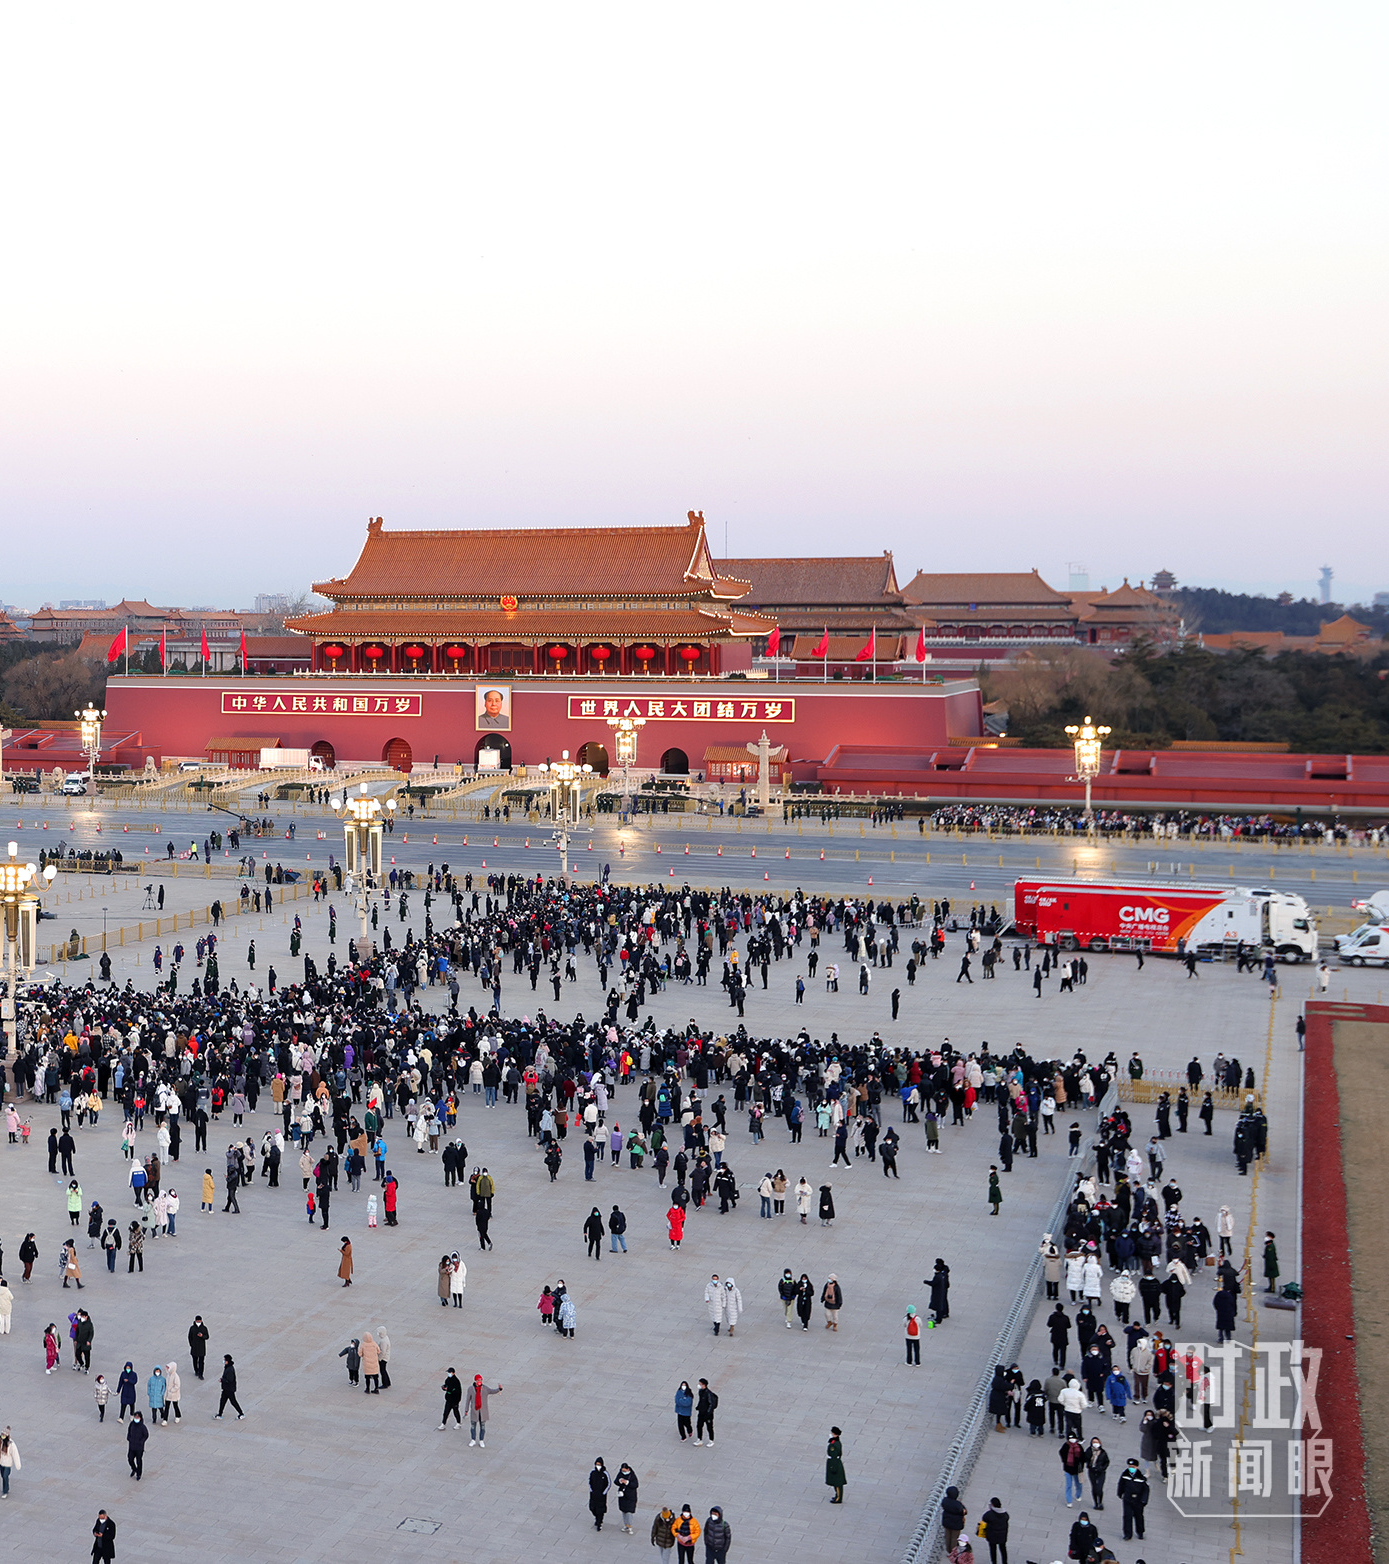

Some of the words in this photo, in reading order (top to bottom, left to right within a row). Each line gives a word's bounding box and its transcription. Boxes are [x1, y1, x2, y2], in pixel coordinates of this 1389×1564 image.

[231, 695, 411, 713] 中华人民共和国万岁
[580, 699, 783, 719] 世界人民大团结万岁
[1119, 906, 1170, 924] CMG
